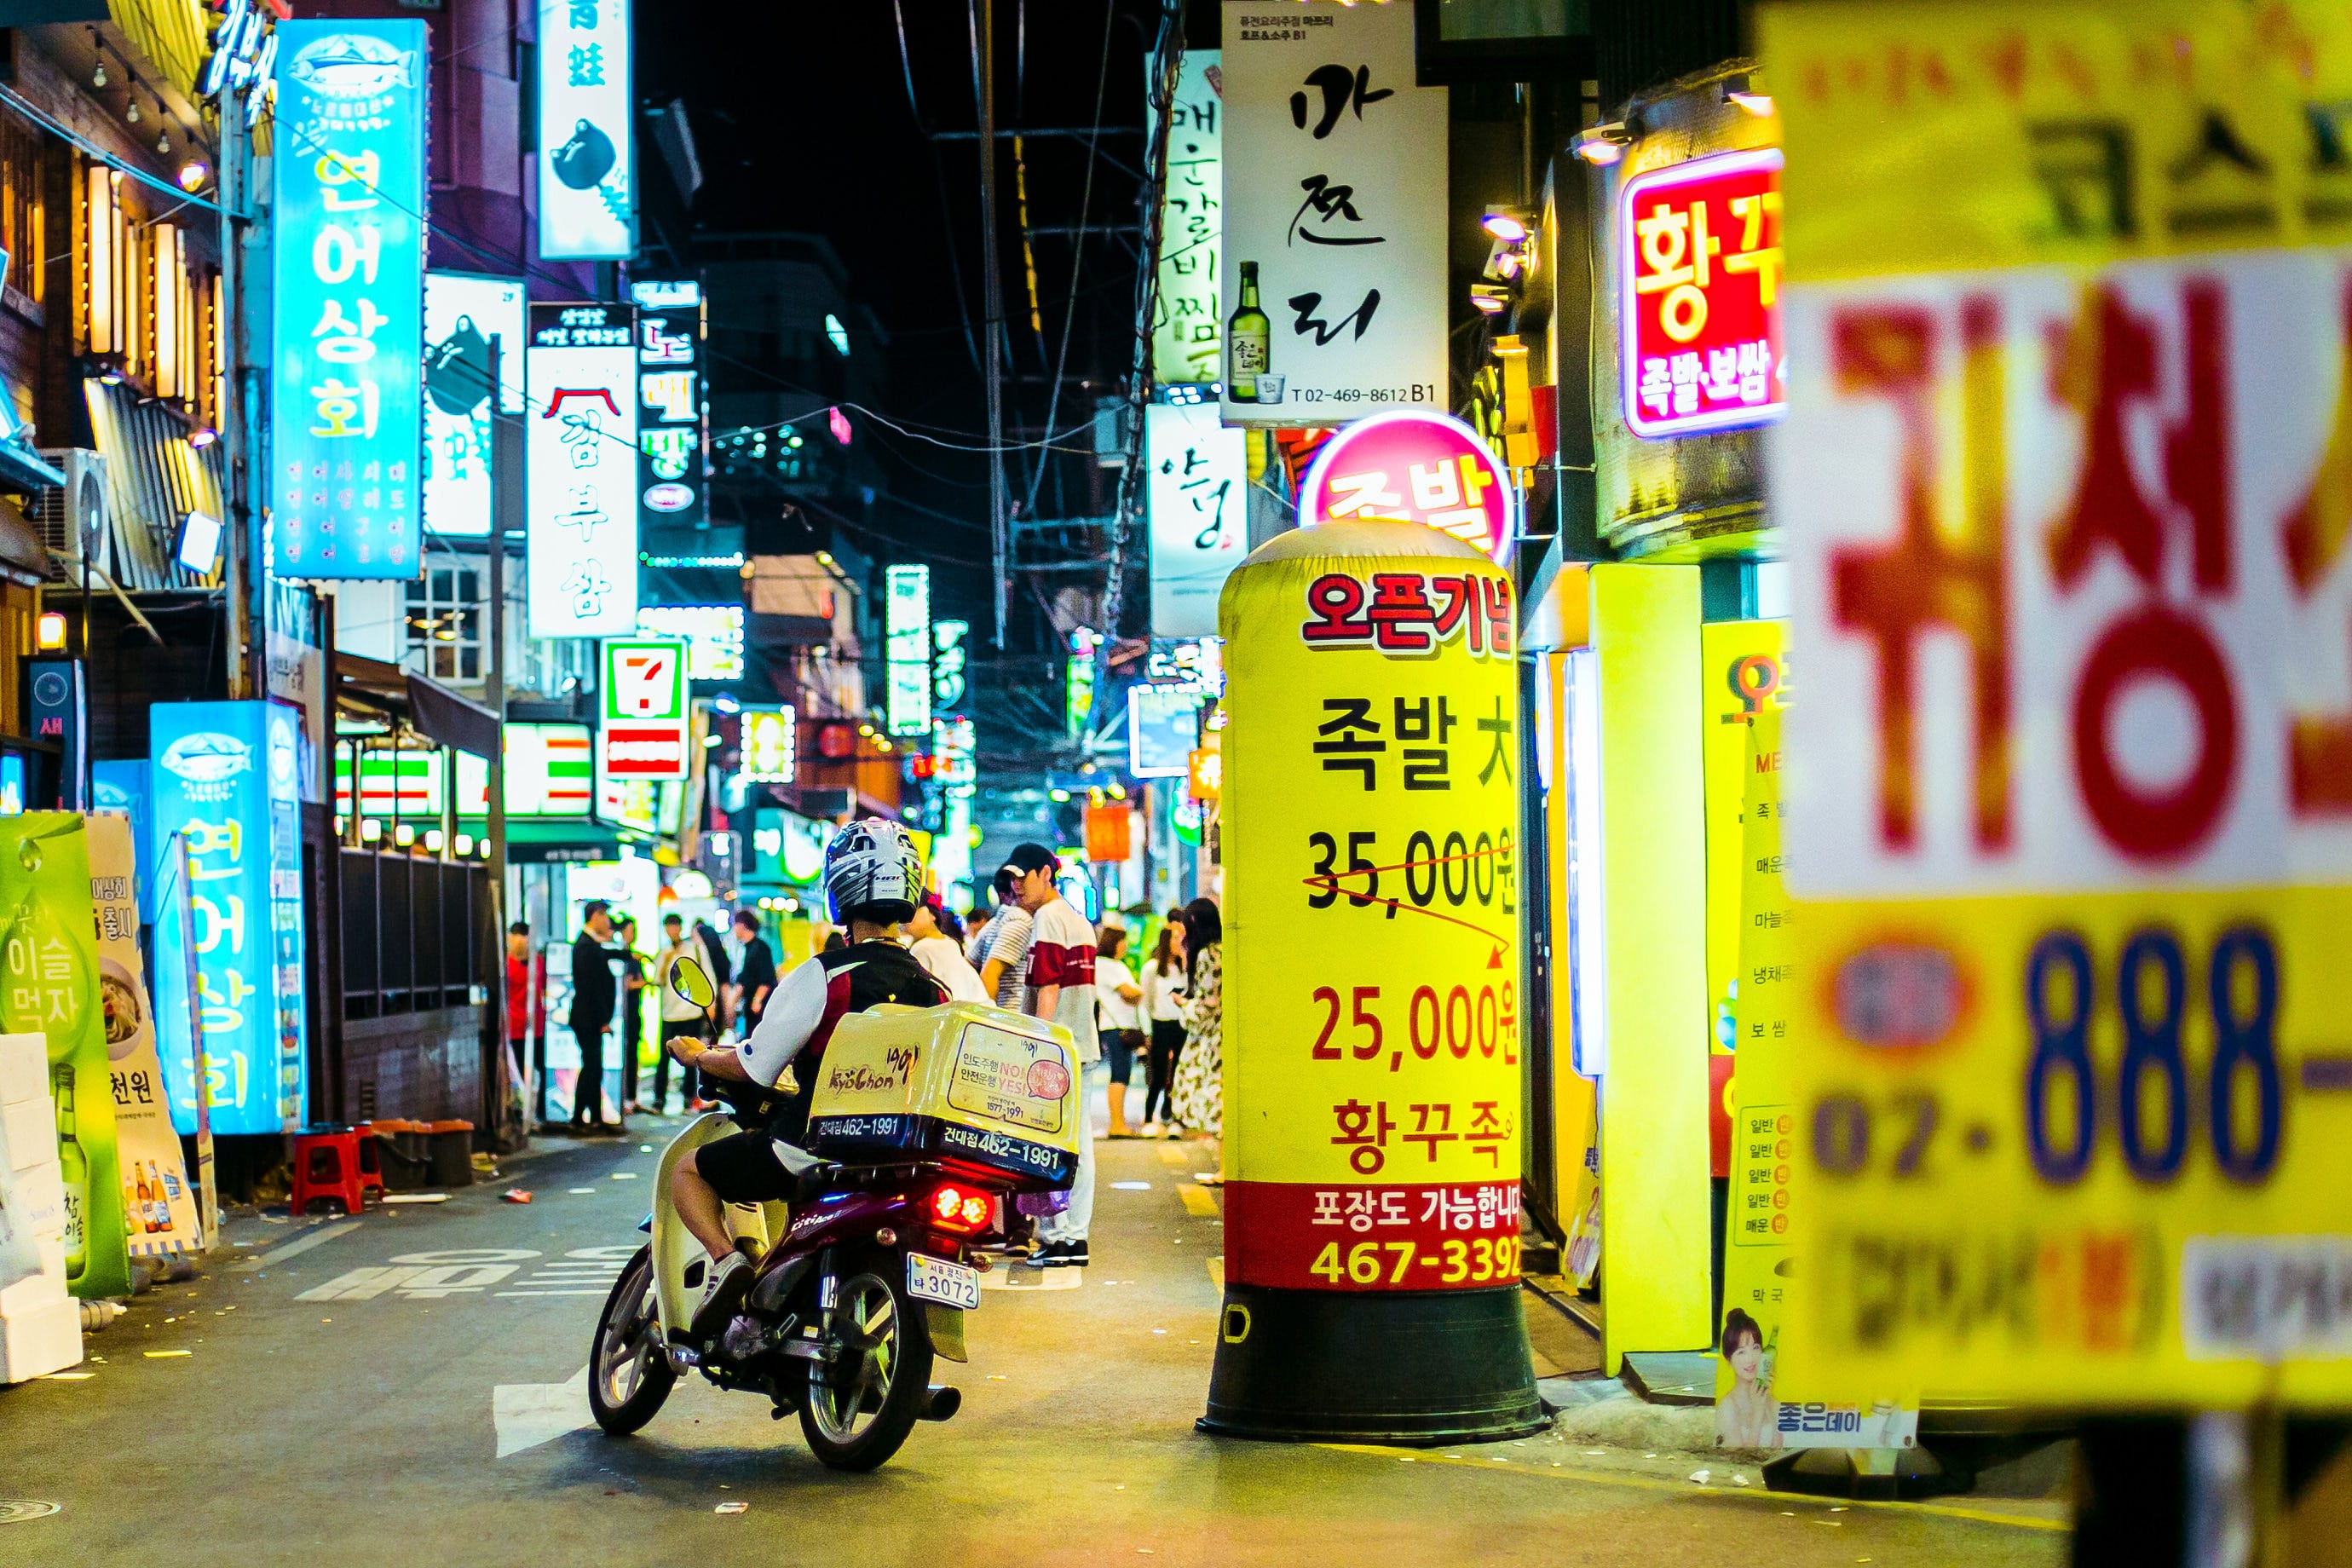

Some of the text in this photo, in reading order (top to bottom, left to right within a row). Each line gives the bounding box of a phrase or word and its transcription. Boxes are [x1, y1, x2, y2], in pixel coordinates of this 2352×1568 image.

[310, 148, 389, 440] 연어상회
[1305, 389, 1407, 402] 02-469-8612
[1410, 384, 1435, 403] B1
[1302, 573, 1513, 659] 오픈기념
[1313, 695, 1458, 792] 족발
[8, 936, 72, 982] 이슬
[181, 816, 256, 1110] 연어상회
[1311, 979, 1518, 1073] 25,000원
[960, 1068, 998, 1088] 안전운행
[963, 1052, 1000, 1074] 인도주행
[1330, 1098, 1506, 1175] 황꾸족
[1750, 1118, 1773, 1134] 일반
[1750, 1143, 1773, 1159] 일반
[1748, 1168, 1772, 1184] 일반
[1311, 1190, 1411, 1233] 포장도
[1747, 1193, 1770, 1209] 일반
[1310, 1237, 1521, 1284] 467-3392
[929, 1275, 975, 1304] 3072
